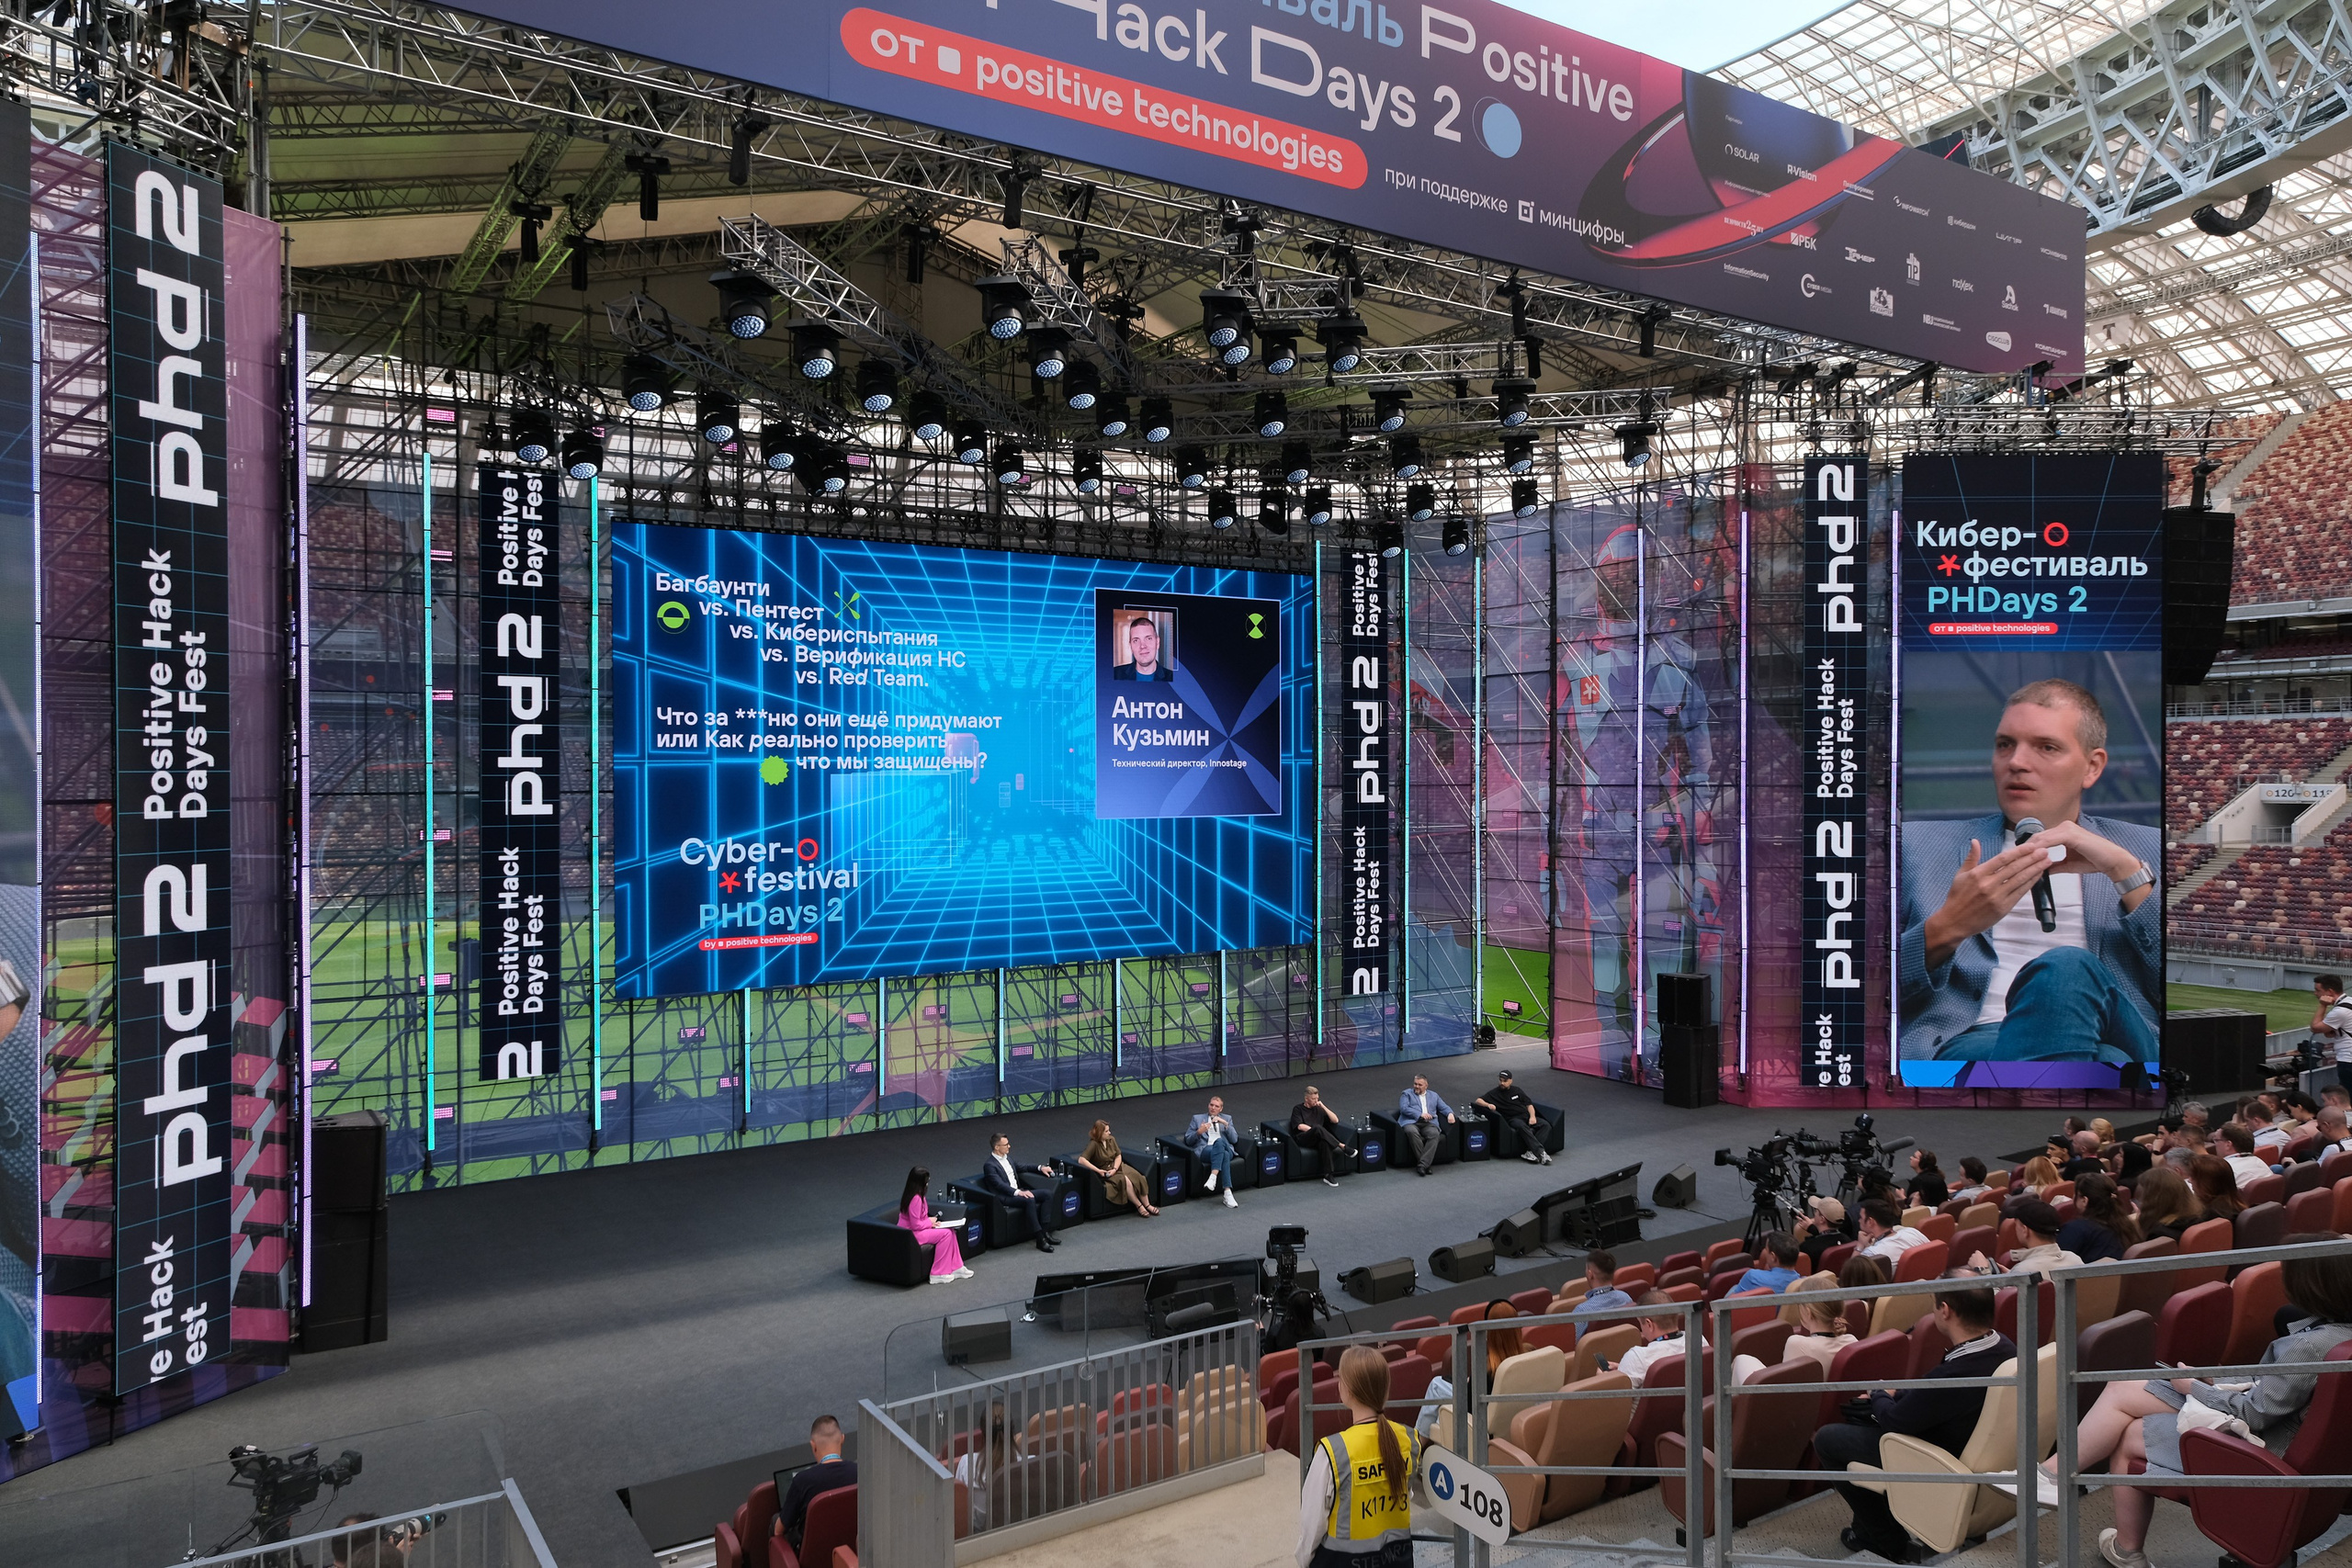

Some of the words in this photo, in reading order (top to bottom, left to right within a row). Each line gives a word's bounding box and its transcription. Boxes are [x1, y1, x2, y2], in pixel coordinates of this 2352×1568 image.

[1251, 25, 1416, 131] Days
[1433, 85, 1461, 142] 2
[1421, 5, 1634, 121] Positive
[977, 55, 1124, 116] positive
[1134, 86, 1343, 174] technologies
[1734, 147, 1759, 164] SOLAR
[135, 165, 202, 256] 2
[1385, 168, 1416, 190] при
[1420, 178, 1509, 213] поддержке
[1799, 234, 1817, 251] РБК
[1987, 334, 2010, 345] CISOCLUB
[2035, 343, 2068, 356] КОМПАНИЯ
[137, 268, 218, 506] phd
[1818, 465, 1854, 501] 2
[498, 488, 518, 585] Positive
[1917, 519, 2036, 550] Кибер-
[523, 530, 548, 586] Days
[1818, 516, 1861, 631] phd
[1963, 551, 2147, 583] фестиваль
[141, 548, 171, 635] Hack
[657, 573, 769, 598] Багбаунти
[1352, 565, 1364, 636] Positive
[1928, 587, 2057, 619] PHDays
[2069, 586, 2086, 612] 2
[699, 602, 728, 615] vs.
[736, 599, 824, 620] Пентест
[1367, 593, 1382, 636] Days
[1957, 625, 1991, 633] positive
[1994, 625, 2050, 633] technologies
[498, 614, 542, 658] 2
[729, 625, 758, 638] vs.
[766, 623, 937, 647] Кибериспытания
[179, 631, 206, 712] Fest
[761, 649, 787, 661] vs.
[796, 645, 931, 670] Верификация
[939, 651, 965, 667] НС
[795, 671, 821, 683] vs.
[830, 667, 867, 684] Red
[874, 669, 928, 686] Team.
[1353, 656, 1378, 688] 2
[1818, 659, 1834, 709] Hack
[657, 707, 697, 725] Что
[705, 713, 728, 726] за
[805, 714, 841, 727] они
[848, 711, 888, 729] ещё
[896, 716, 1001, 732] придумают
[1112, 696, 1182, 718] Антон
[1838, 699, 1853, 741] Fest
[143, 662, 173, 819] Positive
[498, 676, 552, 815] phd
[658, 734, 697, 747] или
[706, 730, 743, 747] Как
[749, 735, 837, 752] реально
[845, 731, 945, 752] проверить
[1114, 724, 1208, 750] Кузьмин
[1353, 702, 1385, 803] phd
[1817, 716, 1834, 797] Positive
[180, 727, 214, 818] Days
[797, 757, 830, 769] что
[837, 757, 866, 769] мы
[874, 751, 988, 770] защищены?
[1112, 758, 1166, 769] Технический
[1167, 760, 1208, 770] директор,
[1209, 759, 1248, 770] Innostage
[1837, 749, 1857, 797] Days
[2275, 789, 2294, 798] 120
[681, 838, 793, 872] Cyber-
[1353, 827, 1365, 868] Hack
[1816, 821, 1852, 857] 2
[499, 847, 518, 908] Hack
[745, 863, 858, 893] festival
[1368, 861, 1379, 898] Fest
[143, 864, 207, 936] 2
[524, 895, 543, 946] Fest
[700, 902, 818, 931] PHDays
[828, 897, 842, 921] 2
[1353, 877, 1365, 948] Positive
[704, 940, 717, 950] by
[727, 938, 758, 948] positive
[760, 932, 812, 947] technologies
[1368, 905, 1382, 947] Days
[1816, 873, 1860, 987] phd
[498, 918, 519, 1015] Positive
[524, 954, 548, 1013] Days
[1353, 967, 1378, 995] 2
[498, 1041, 542, 1080] 2
[1815, 1014, 1832, 1065] Hack
[144, 959, 221, 1189] phd
[143, 1235, 173, 1342] Hack
[1358, 1457, 1409, 1480] SAFY
[1460, 1483, 1503, 1528] 108
